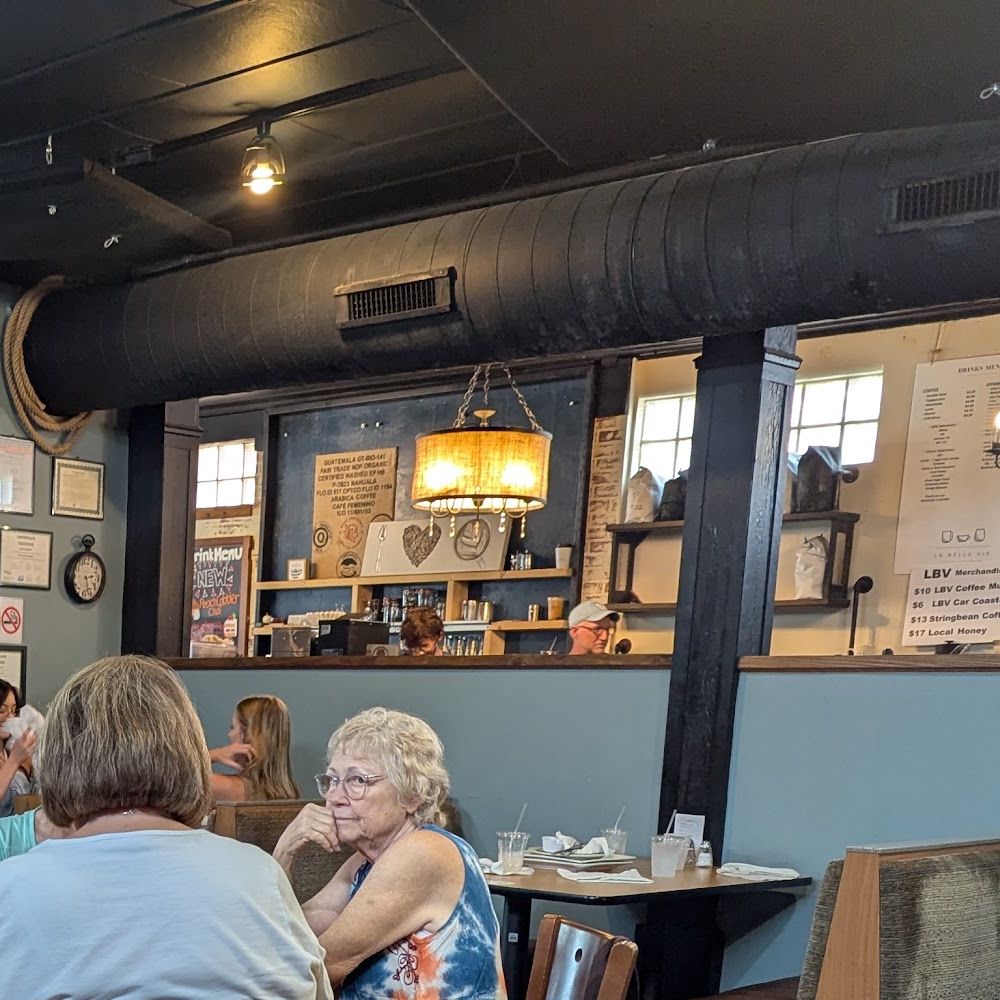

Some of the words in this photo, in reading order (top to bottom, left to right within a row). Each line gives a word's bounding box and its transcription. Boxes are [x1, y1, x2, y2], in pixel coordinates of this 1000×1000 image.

[324, 457, 355, 465] GUATEMALA
[364, 461, 388, 469] ORGANIC
[318, 474, 344, 482] CERTIFIED
[345, 471, 368, 479] WASHED
[351, 478, 377, 486] NAHUALA
[355, 492, 376, 500] COFFEE
[194, 547, 214, 562] rink
[214, 547, 243, 561] Menu
[197, 567, 228, 588] NEW
[924, 568, 952, 579] LBV
[914, 587, 931, 596] $10
[934, 585, 953, 594] LBV
[955, 584, 986, 592] Coffee
[912, 601, 924, 609] $6
[932, 599, 951, 607] LBV
[953, 598, 970, 606] Car
[972, 596, 1000, 605] Coast
[911, 616, 928, 624] $13
[929, 614, 979, 623] Stringbean
[909, 629, 926, 637] $17
[928, 628, 954, 636] Local
[957, 627, 988, 636] Honey
